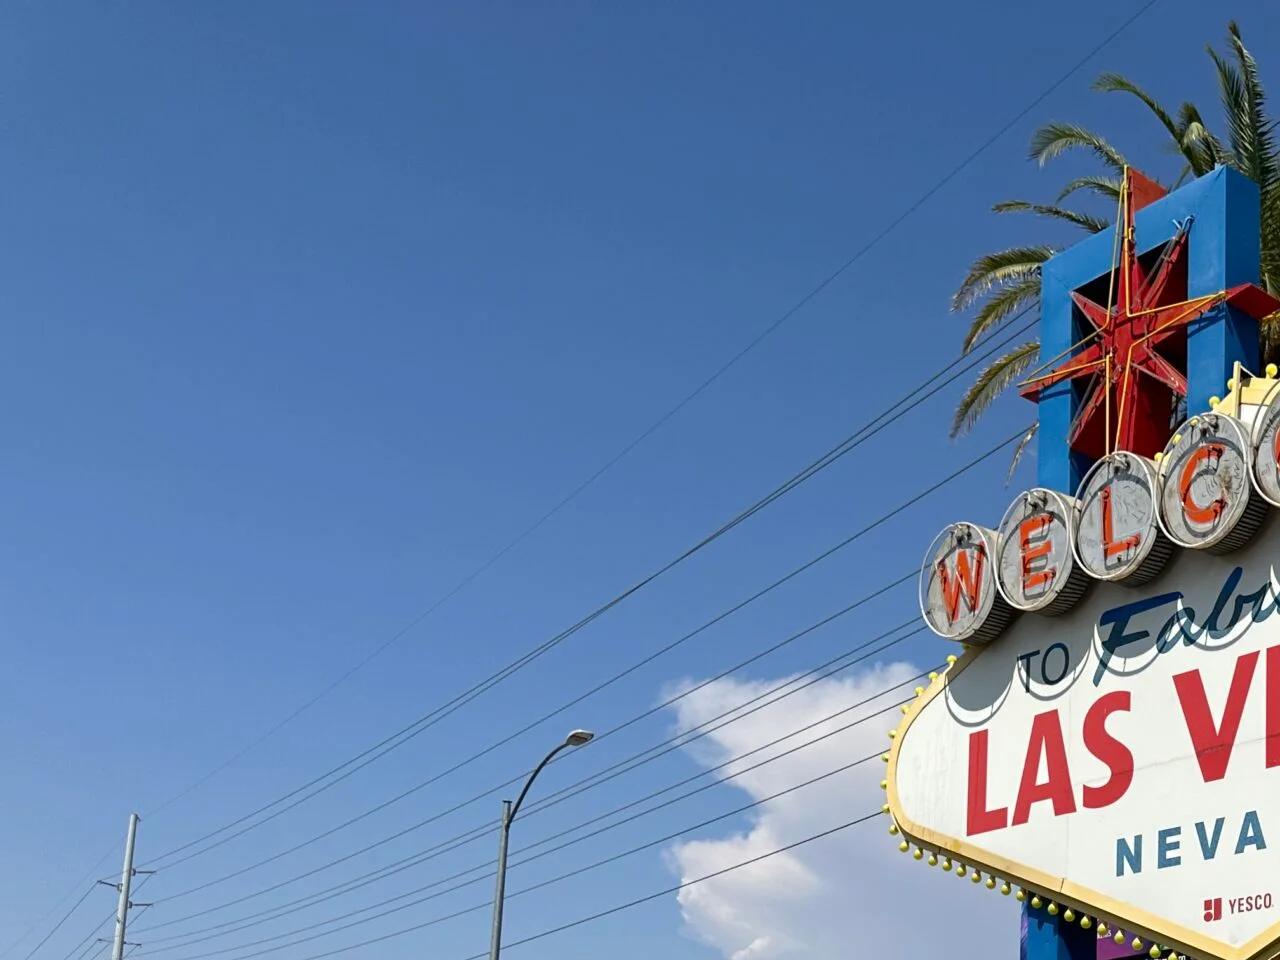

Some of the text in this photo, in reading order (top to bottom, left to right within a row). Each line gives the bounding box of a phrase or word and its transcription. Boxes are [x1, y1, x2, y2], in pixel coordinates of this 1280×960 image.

[1018, 641, 1070, 693] TO
[966, 690, 1134, 836] LAS
[1228, 893, 1272, 914] YESCO
